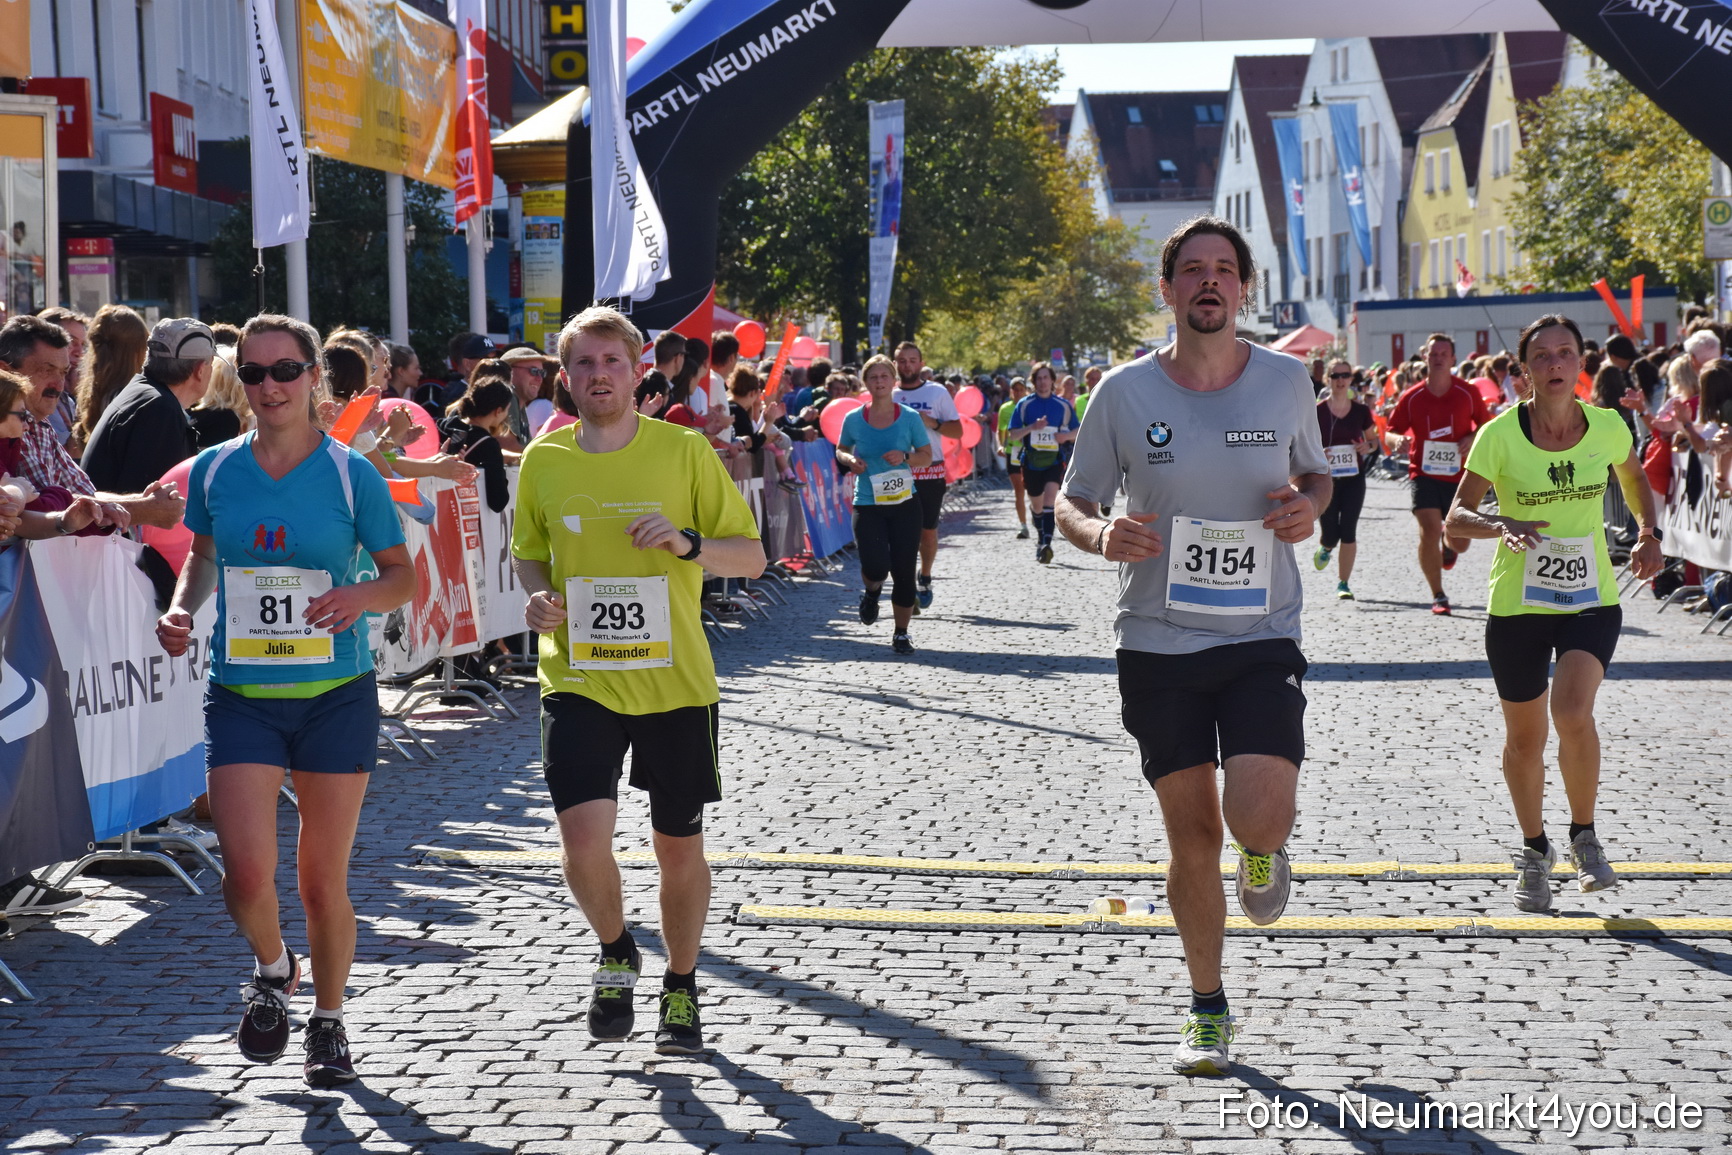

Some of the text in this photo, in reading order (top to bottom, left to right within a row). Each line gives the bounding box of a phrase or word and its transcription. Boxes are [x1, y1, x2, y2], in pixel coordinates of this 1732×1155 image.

[696, 0, 839, 93] NEUMARKT
[635, 211, 661, 272] PARTL
[1148, 421, 1171, 432] BMW
[1037, 433, 1052, 441] 121
[1225, 430, 1277, 443] BOCK
[1147, 451, 1174, 460] PARTL
[1331, 454, 1353, 465] 2183
[1428, 450, 1456, 462] 2432
[882, 478, 904, 491] 238
[1516, 490, 1529, 498] SC
[1202, 528, 1245, 540] BOCK
[1550, 543, 1583, 553] BOCK
[1185, 544, 1256, 575] 3154
[1536, 555, 1588, 581] 2299
[255, 576, 301, 587] BOCK
[1189, 576, 1211, 584] PARTL
[594, 584, 638, 594] BOCK
[1554, 592, 1573, 603] Rita
[260, 594, 292, 625] 81
[591, 602, 645, 630] 293
[264, 642, 295, 655] Julia
[591, 646, 651, 659] Alexander
